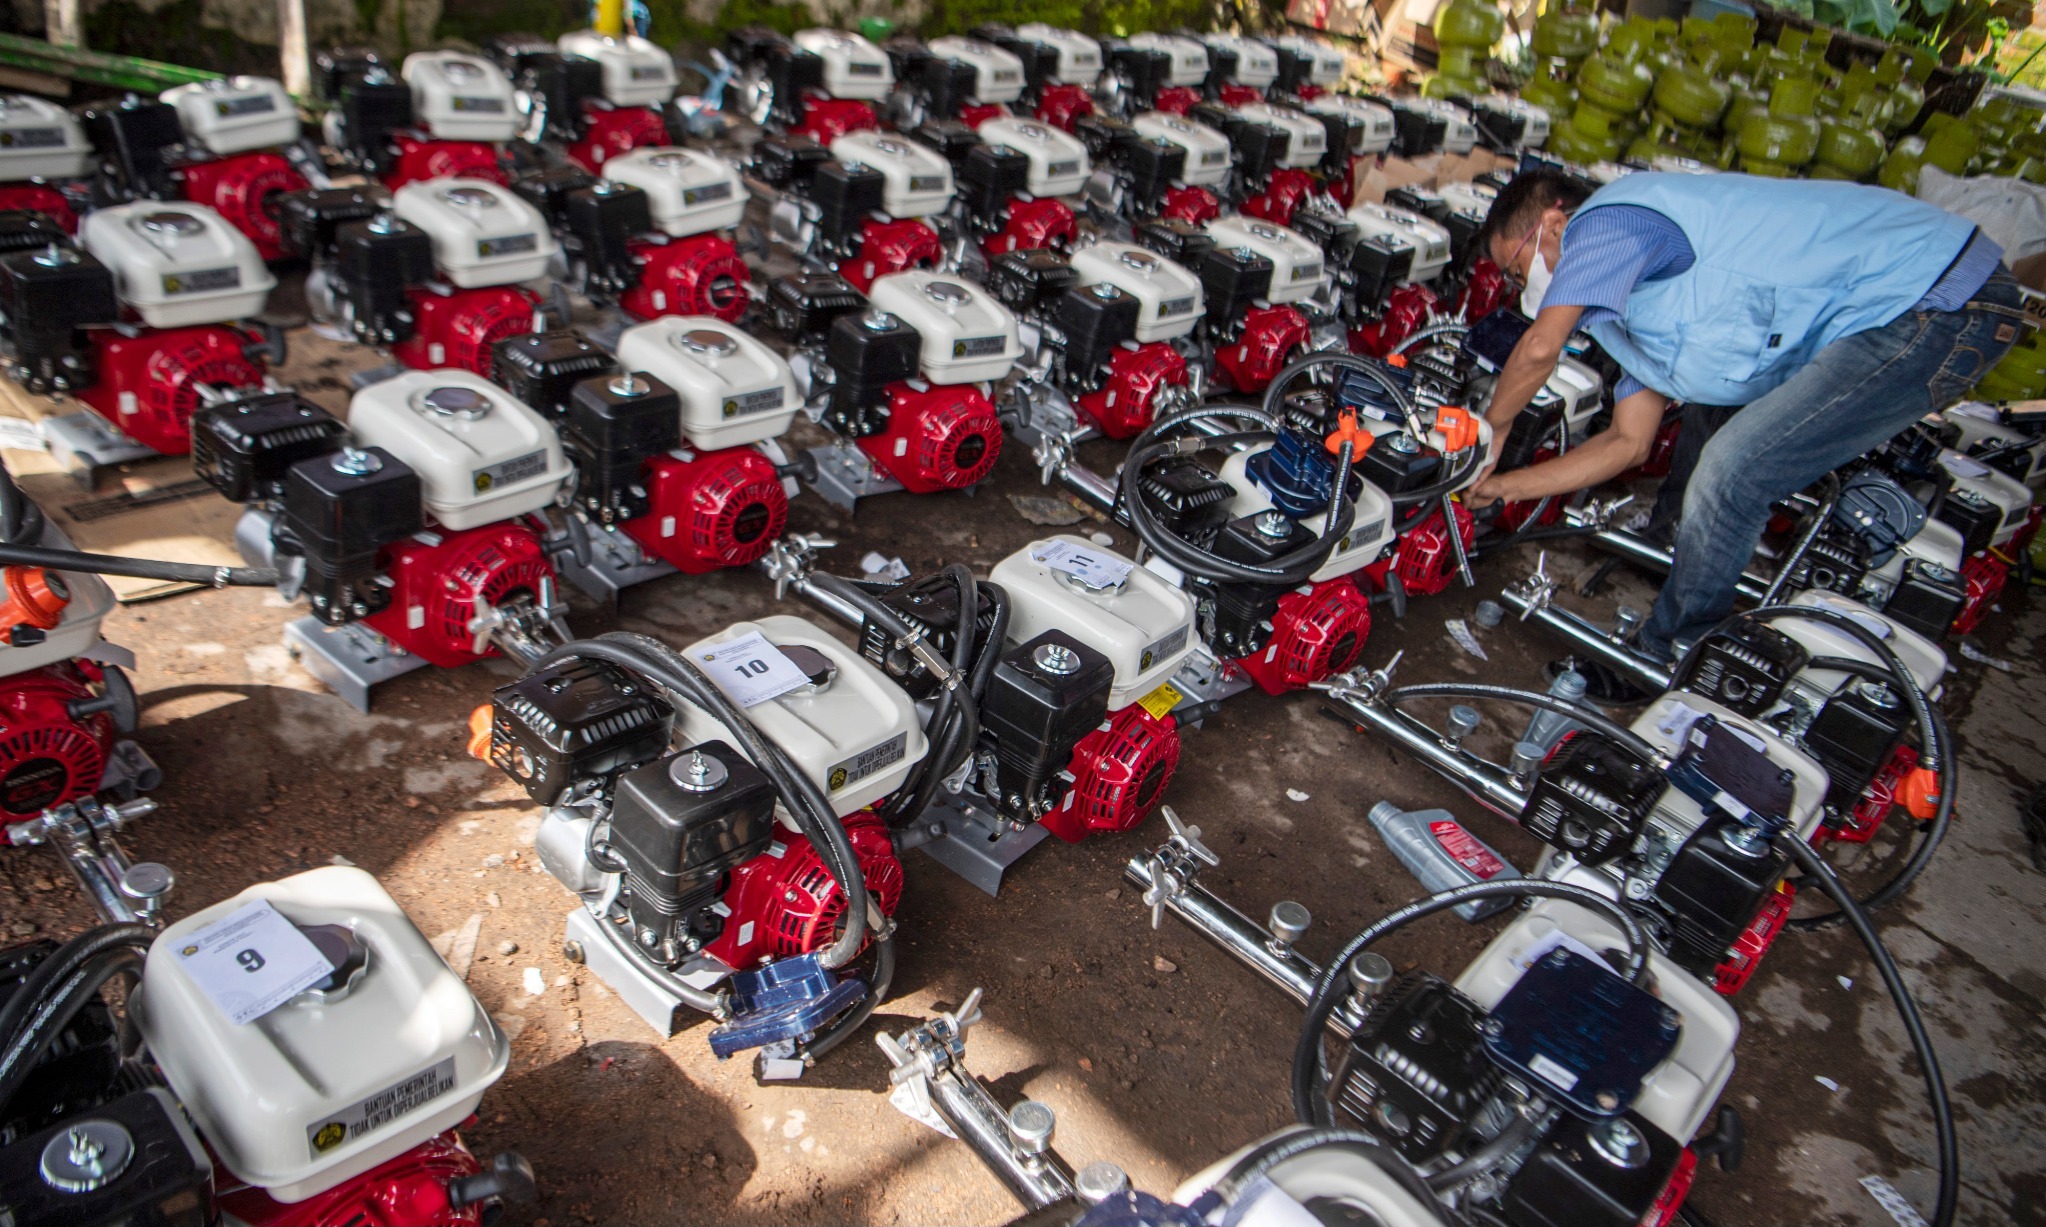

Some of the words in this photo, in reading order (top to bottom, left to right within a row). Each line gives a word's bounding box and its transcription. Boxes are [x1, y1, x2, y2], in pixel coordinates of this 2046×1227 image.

[1068, 554, 1095, 568] 11
[734, 659, 770, 679] 10
[235, 948, 267, 974] 9
[364, 1090, 396, 1117] BANTUAN
[396, 1069, 437, 1101] PEMERINTAH
[350, 1118, 370, 1139] TIDAK
[371, 1107, 393, 1130] UNTUK
[393, 1075, 454, 1118] DIPERJUALBELIKAN
